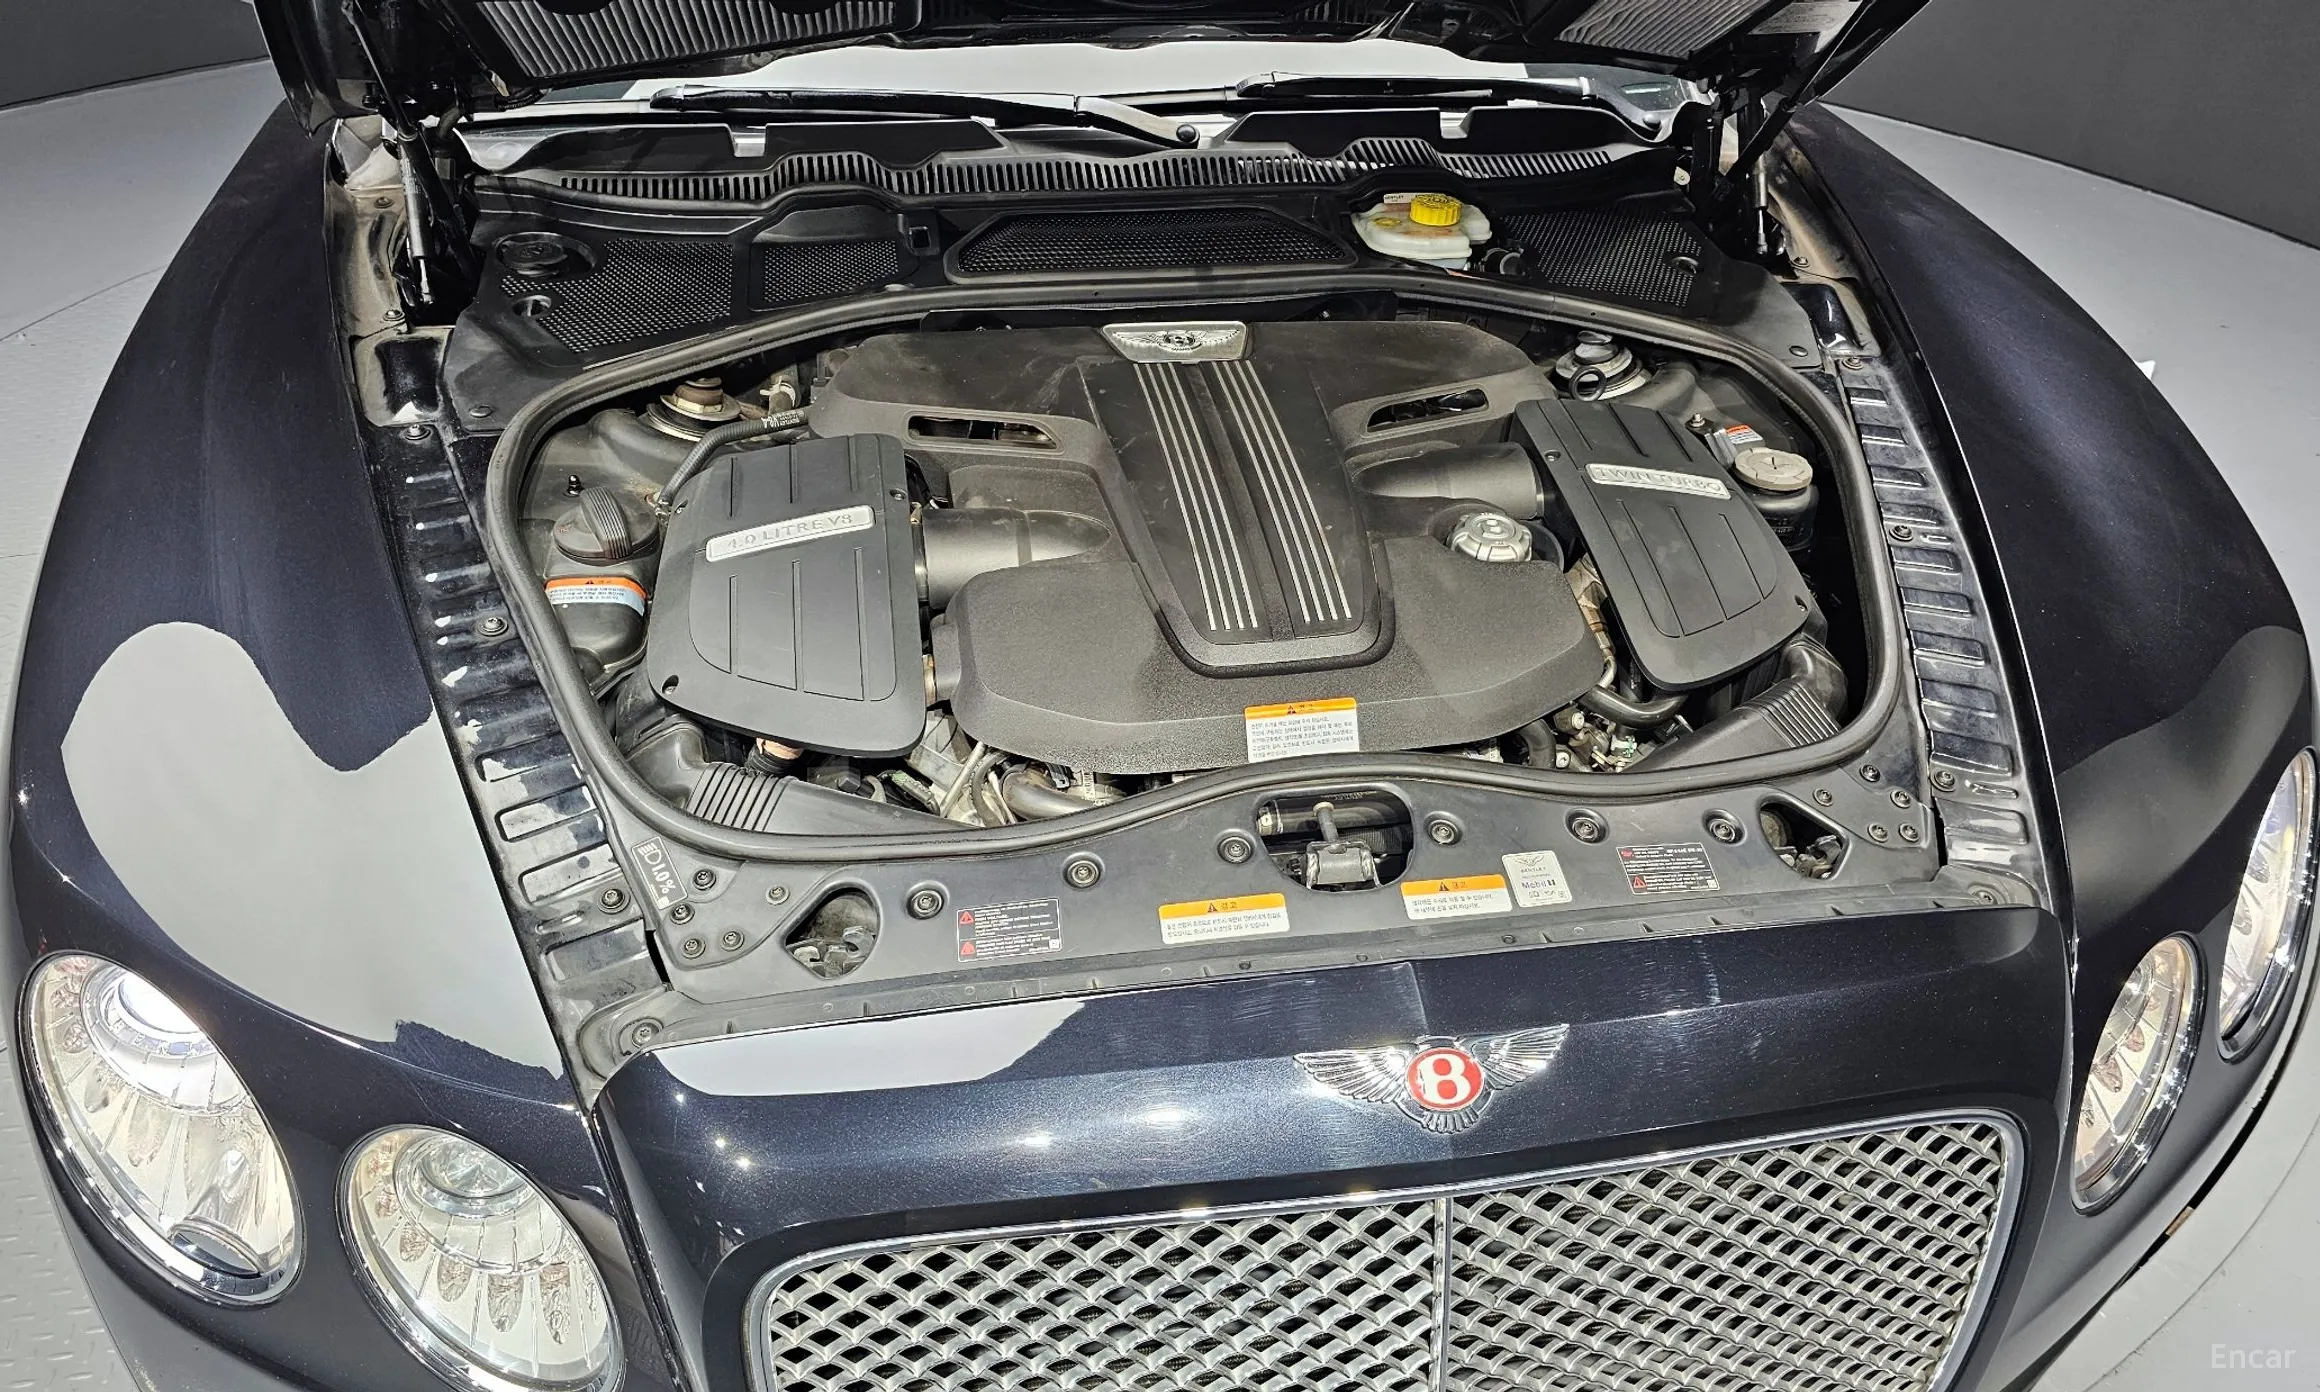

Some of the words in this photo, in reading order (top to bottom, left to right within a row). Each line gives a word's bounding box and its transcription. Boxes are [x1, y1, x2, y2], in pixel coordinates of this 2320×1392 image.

[1595, 467, 1652, 482] TWIN
[1656, 474, 1722, 492] TURBO
[763, 519, 824, 540] LITRE
[828, 514, 852, 526] V8
[652, 862, 676, 894] 1.0%
[1417, 1053, 1472, 1105] B
